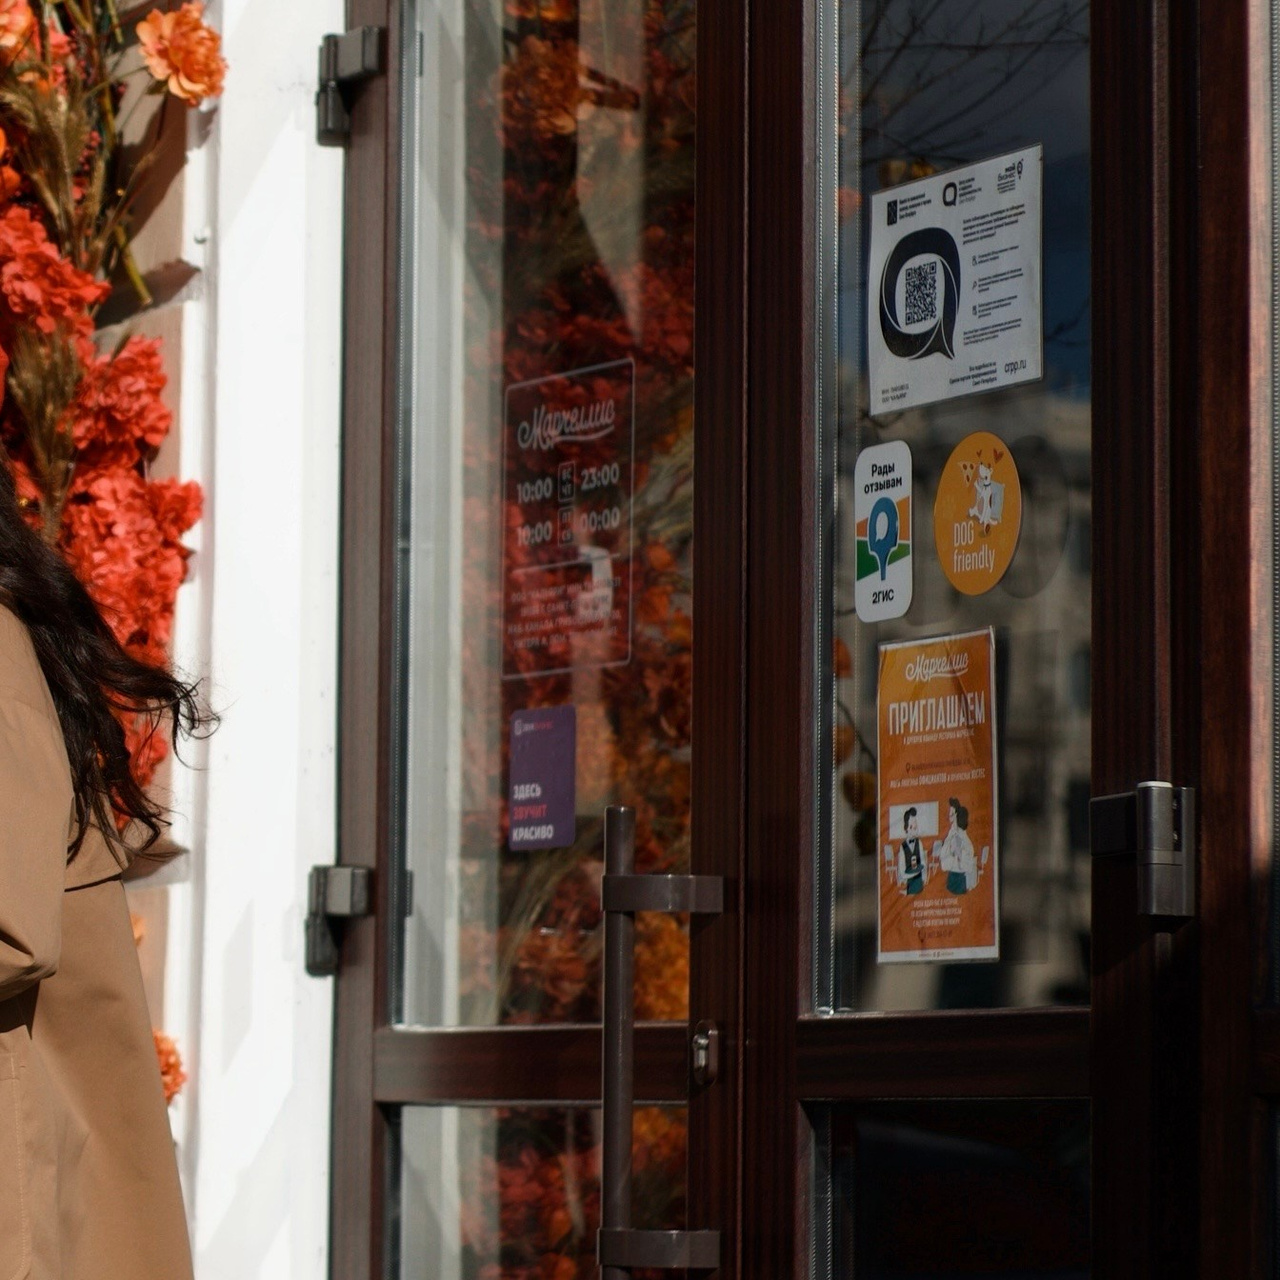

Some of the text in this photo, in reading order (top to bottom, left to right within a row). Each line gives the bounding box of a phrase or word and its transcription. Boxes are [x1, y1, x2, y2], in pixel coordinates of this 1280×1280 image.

[1004, 360, 1026, 375] crpp.ru
[581, 462, 619, 491] 23:00
[871, 462, 895, 478] Рады
[516, 477, 552, 504] 10:00
[863, 475, 902, 494] отзывам
[580, 506, 620, 533] 00:00
[516, 520, 553, 547] 10:00
[953, 520, 975, 547] DOG
[953, 544, 995, 574] friendly
[872, 588, 894, 604] 2ГИС
[888, 690, 985, 736] ПРИГЛАШАЕМ
[513, 782, 541, 801] ЗДЕСЬ
[513, 803, 547, 821] ЗВУЧИТ
[512, 823, 554, 842] КРАСИВО
